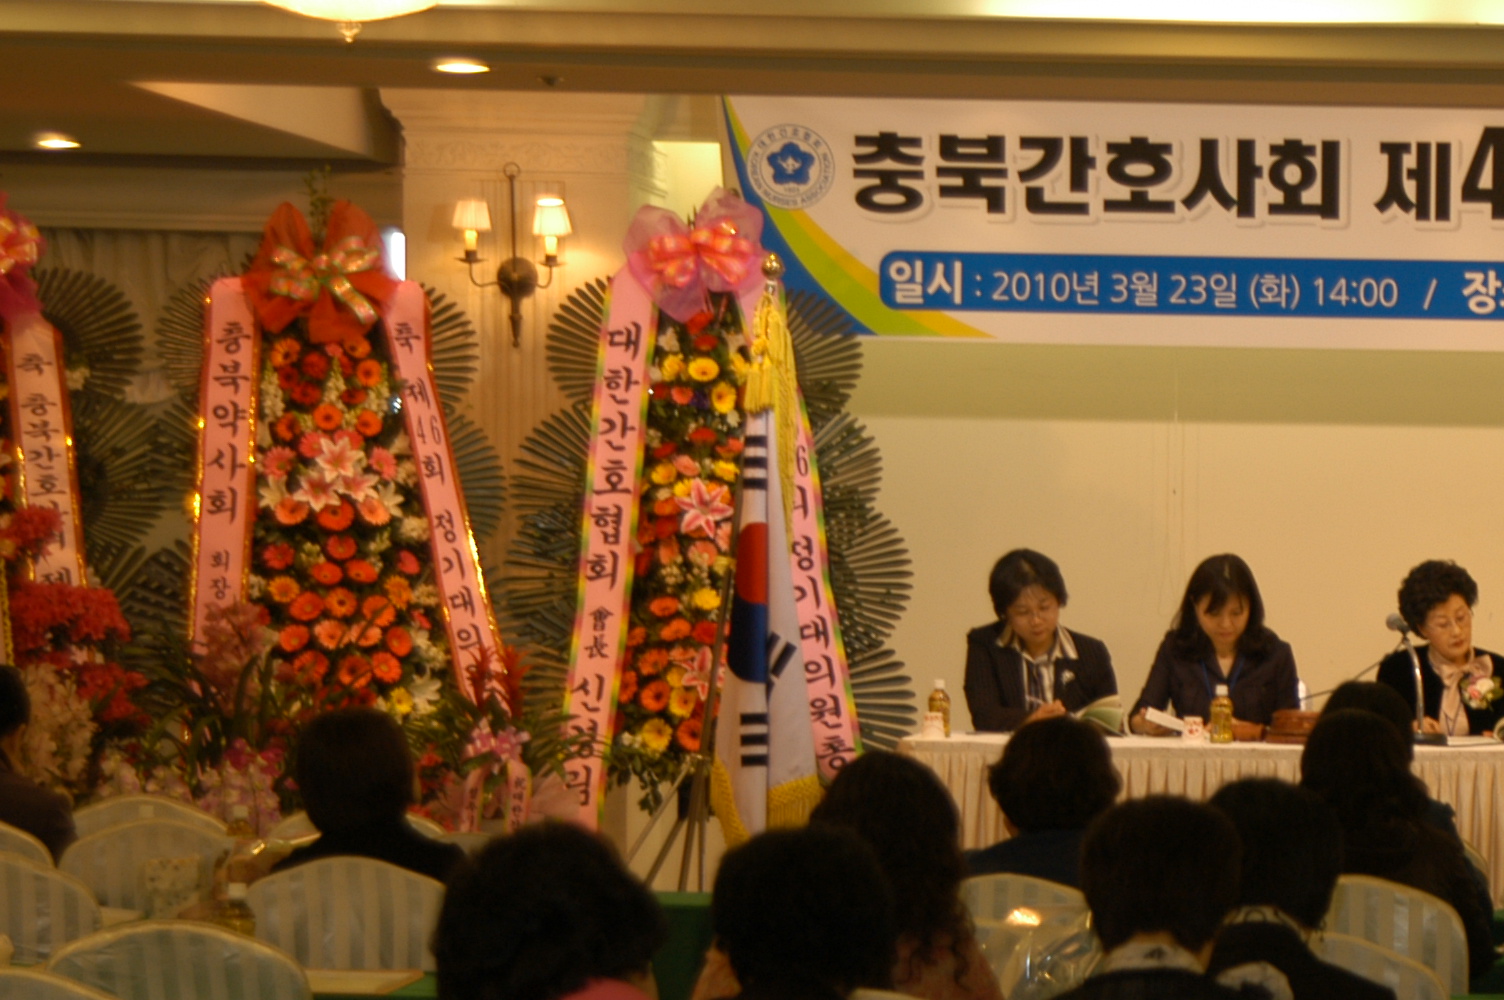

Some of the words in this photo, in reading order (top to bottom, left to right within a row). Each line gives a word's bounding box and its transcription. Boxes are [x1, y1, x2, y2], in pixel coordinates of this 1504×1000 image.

[852, 131, 1341, 221] 충북간호사회
[991, 270, 1100, 306] 2010년
[1110, 272, 1158, 307] 3월
[1169, 274, 1237, 308] 23일
[1249, 274, 1300, 310] (화)
[1312, 276, 1398, 308] 14:00
[205, 320, 251, 525] 충북약사회
[586, 320, 643, 591] 대한간호협회
[209, 548, 232, 600] 회장
